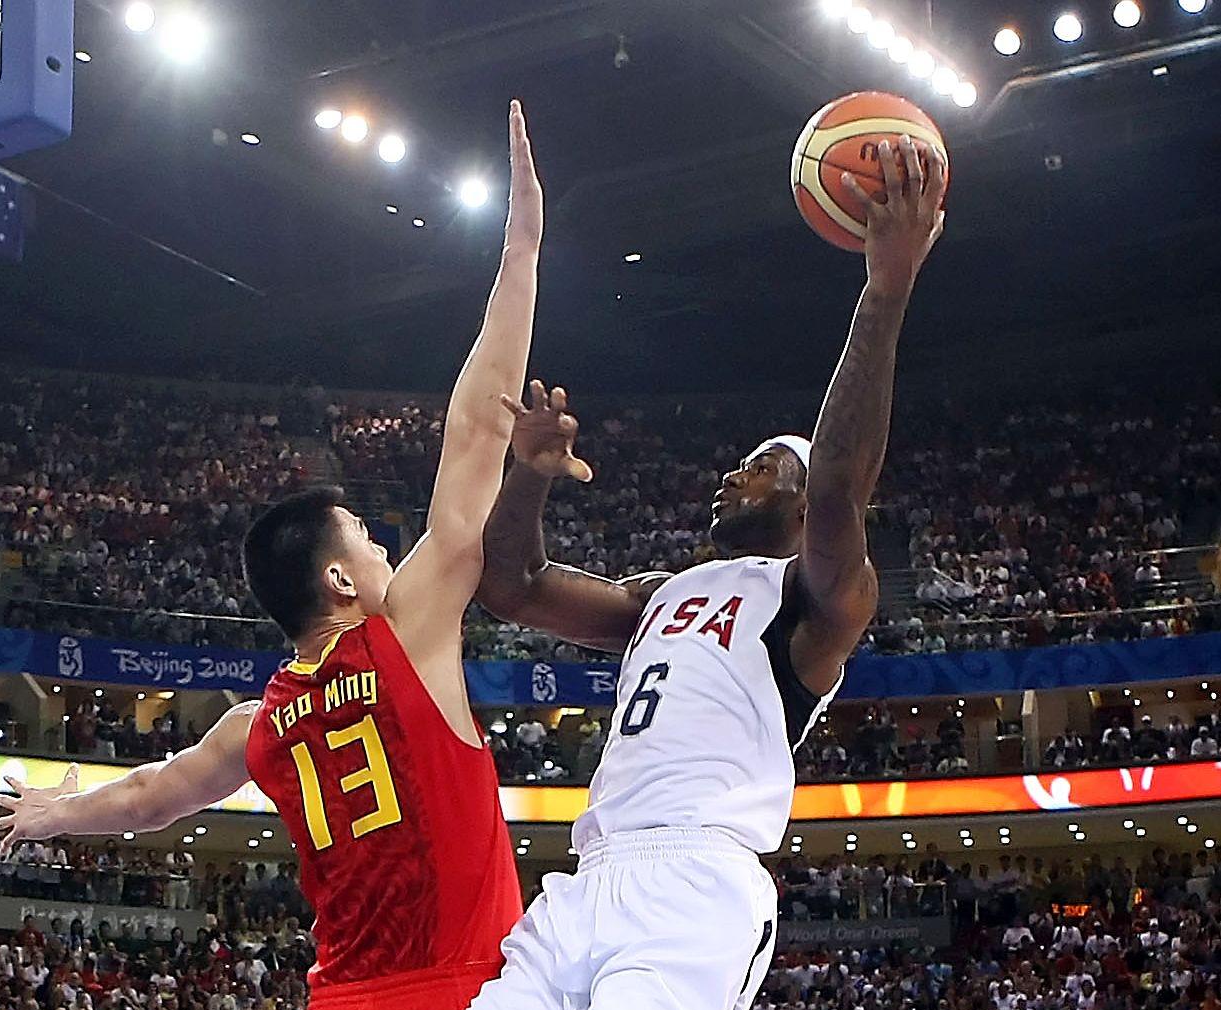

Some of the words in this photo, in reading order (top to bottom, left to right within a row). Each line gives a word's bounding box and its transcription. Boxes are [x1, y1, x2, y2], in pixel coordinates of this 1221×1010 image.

[628, 596, 743, 655] USA
[111, 649, 193, 684] Beijing
[197, 657, 254, 683] 2008
[620, 662, 669, 736] 6
[270, 692, 313, 737] Yao
[325, 671, 377, 712] Ming
[291, 714, 402, 850] 13
